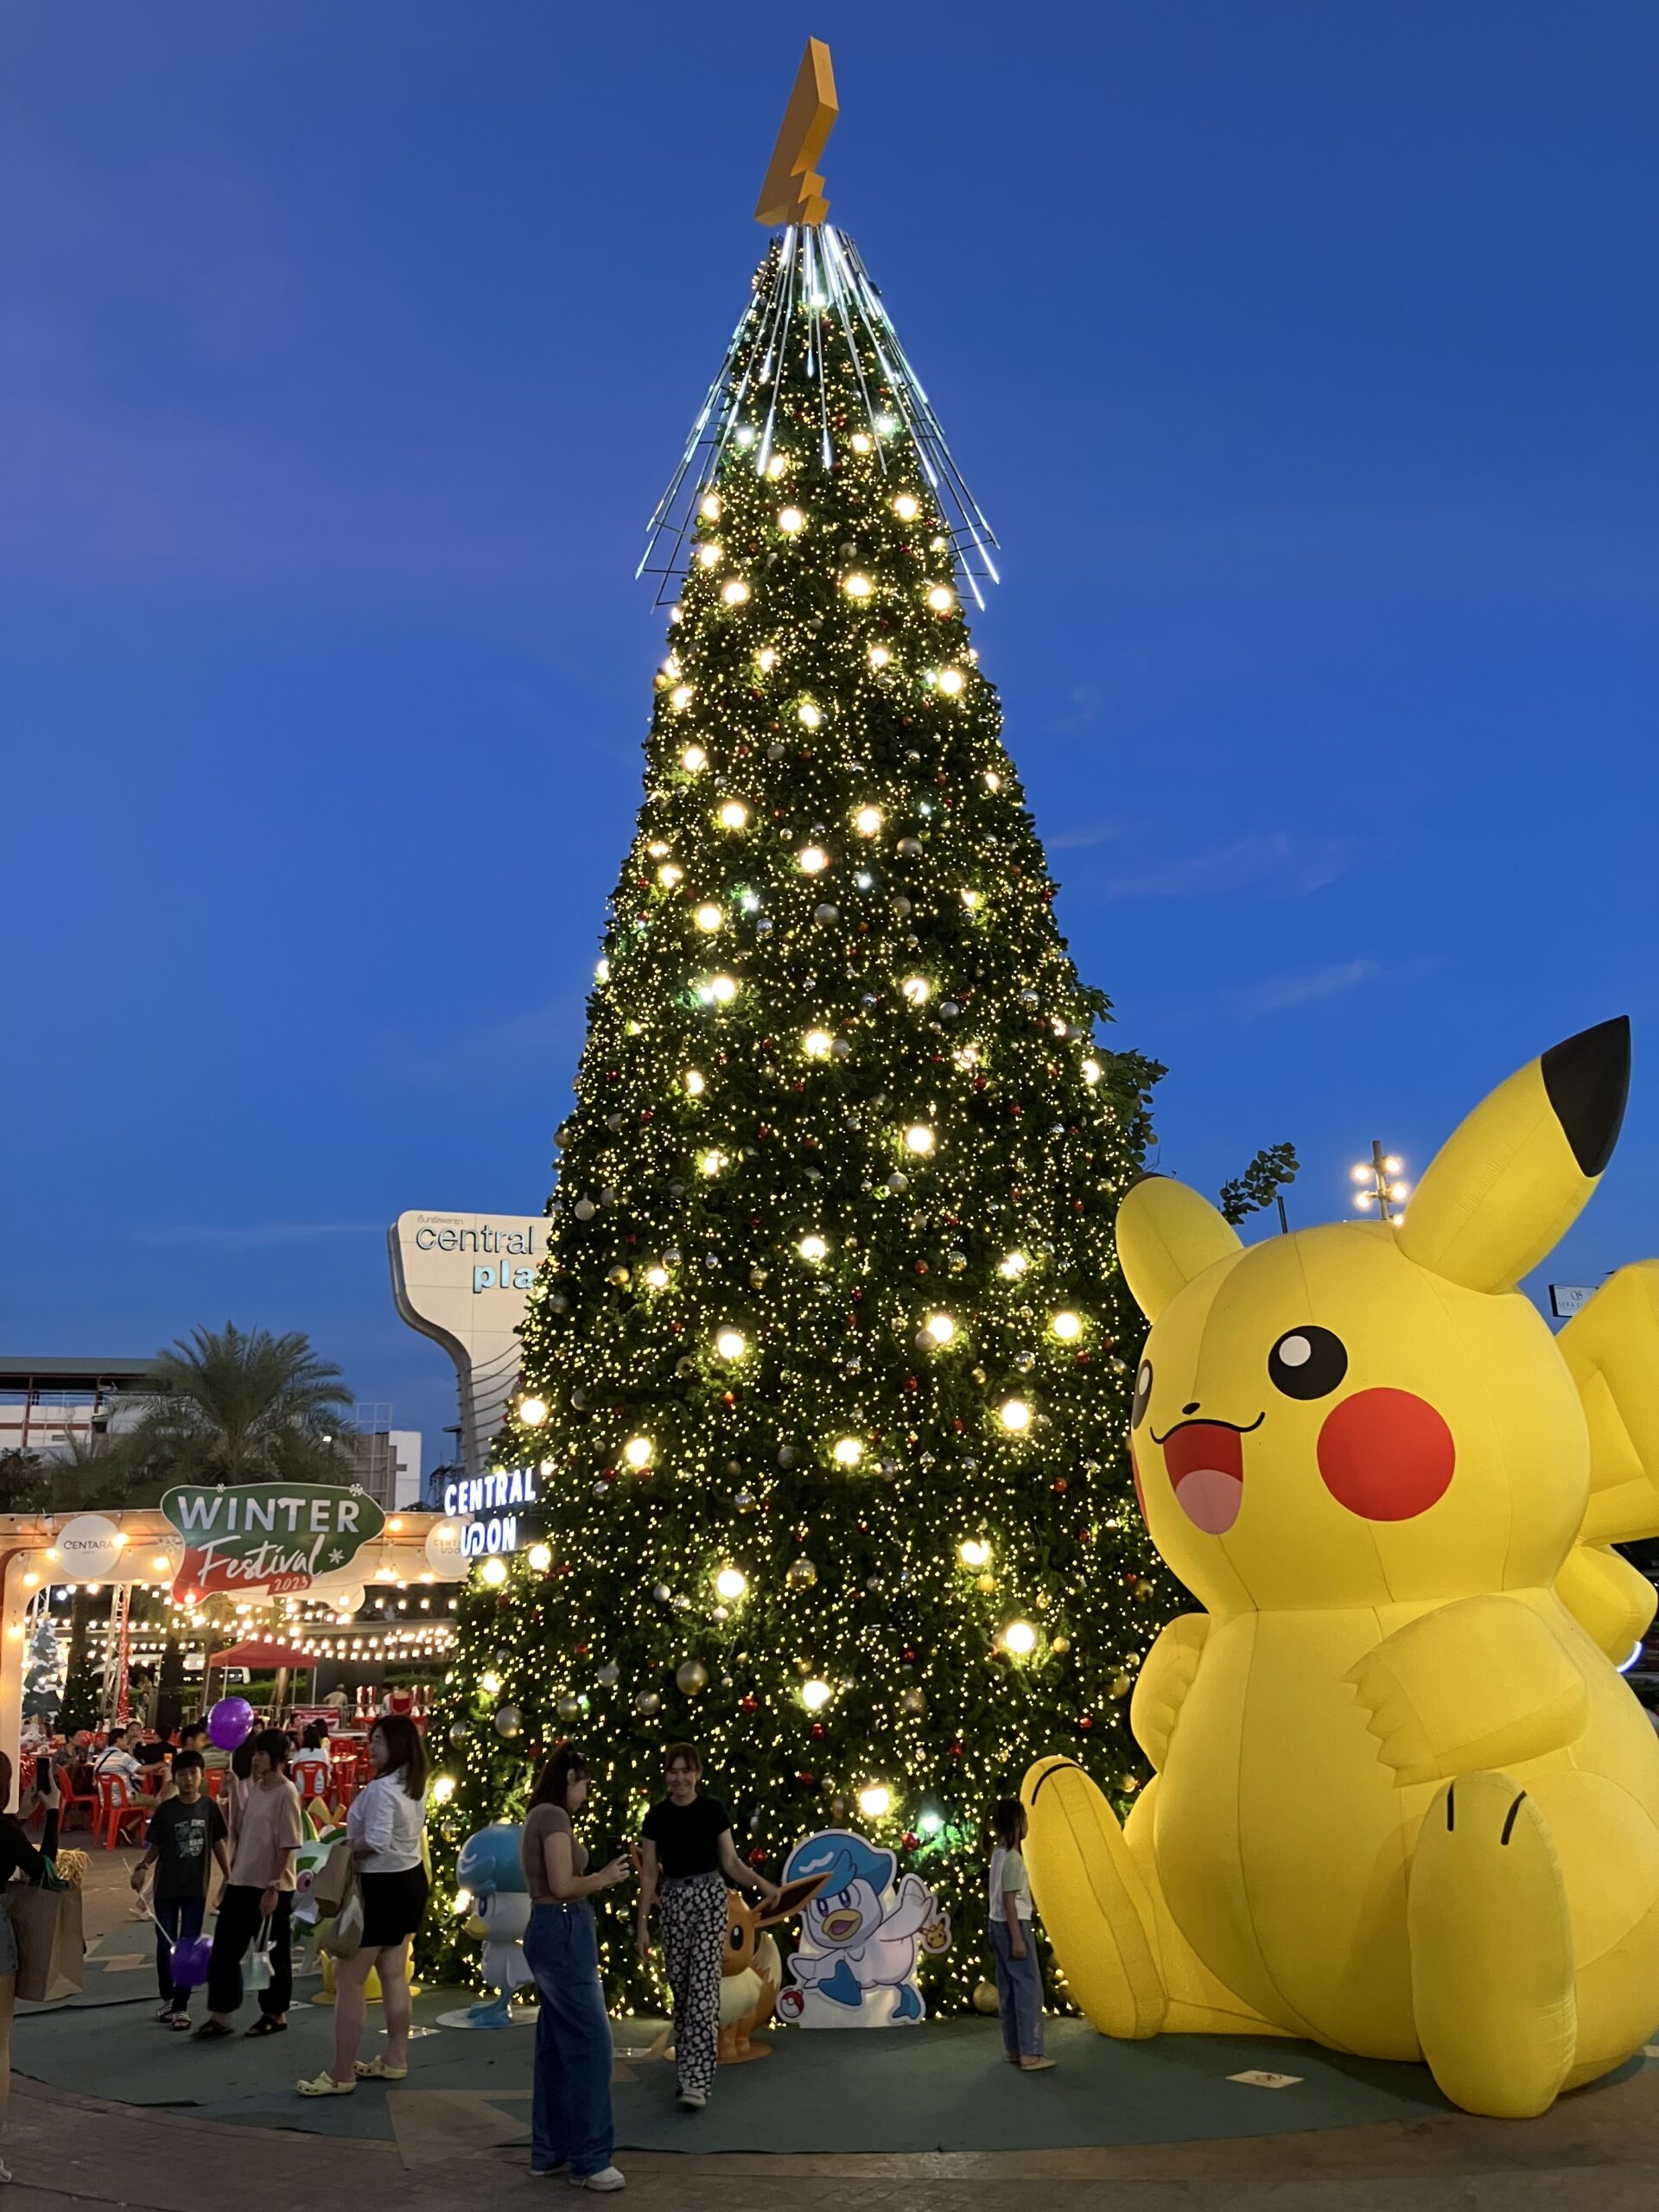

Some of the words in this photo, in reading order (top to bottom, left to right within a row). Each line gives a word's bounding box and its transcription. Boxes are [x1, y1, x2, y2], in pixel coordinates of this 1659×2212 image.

[416, 1224, 536, 1255] central
[473, 1260, 537, 1294] pla
[444, 1467, 536, 1516] CENTRAL
[177, 1496, 360, 1533] WINTER
[63, 1540, 114, 1550] CENTARA
[461, 1516, 517, 1556] UDON
[197, 1534, 326, 1587] Festival
[273, 1576, 309, 1591] 2023
